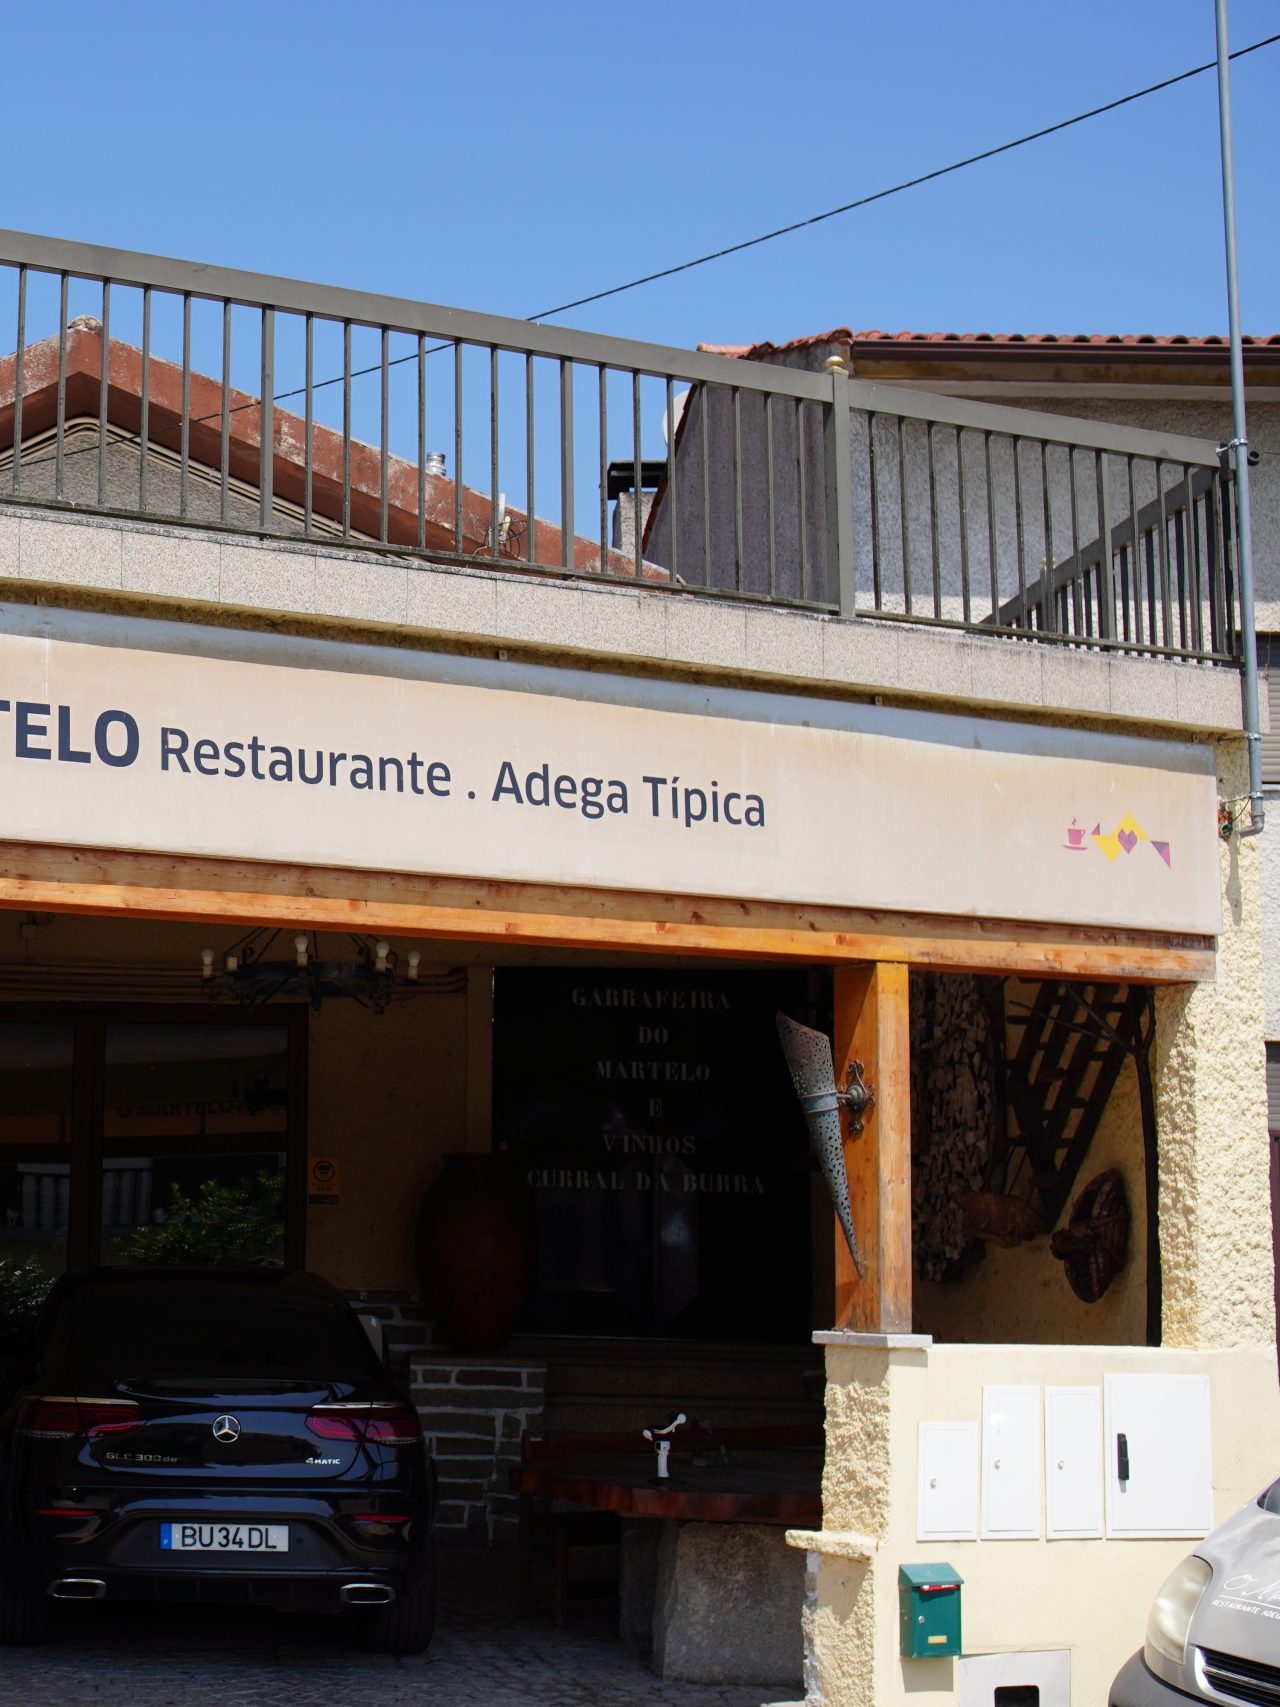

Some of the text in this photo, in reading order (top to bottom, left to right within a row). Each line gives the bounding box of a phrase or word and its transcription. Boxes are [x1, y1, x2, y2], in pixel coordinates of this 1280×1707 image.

[160, 727, 451, 797] Restaurante
[492, 761, 628, 820] Adega
[643, 776, 766, 828] Típica
[572, 988, 731, 1009] GARRAFEIRA
[638, 1026, 669, 1044] DO
[597, 1060, 711, 1081] MARTELO
[649, 1099, 663, 1118] E
[602, 1135, 696, 1153] VINHOS
[527, 1168, 624, 1190] CURRAL
[682, 1173, 766, 1194] BURRA
